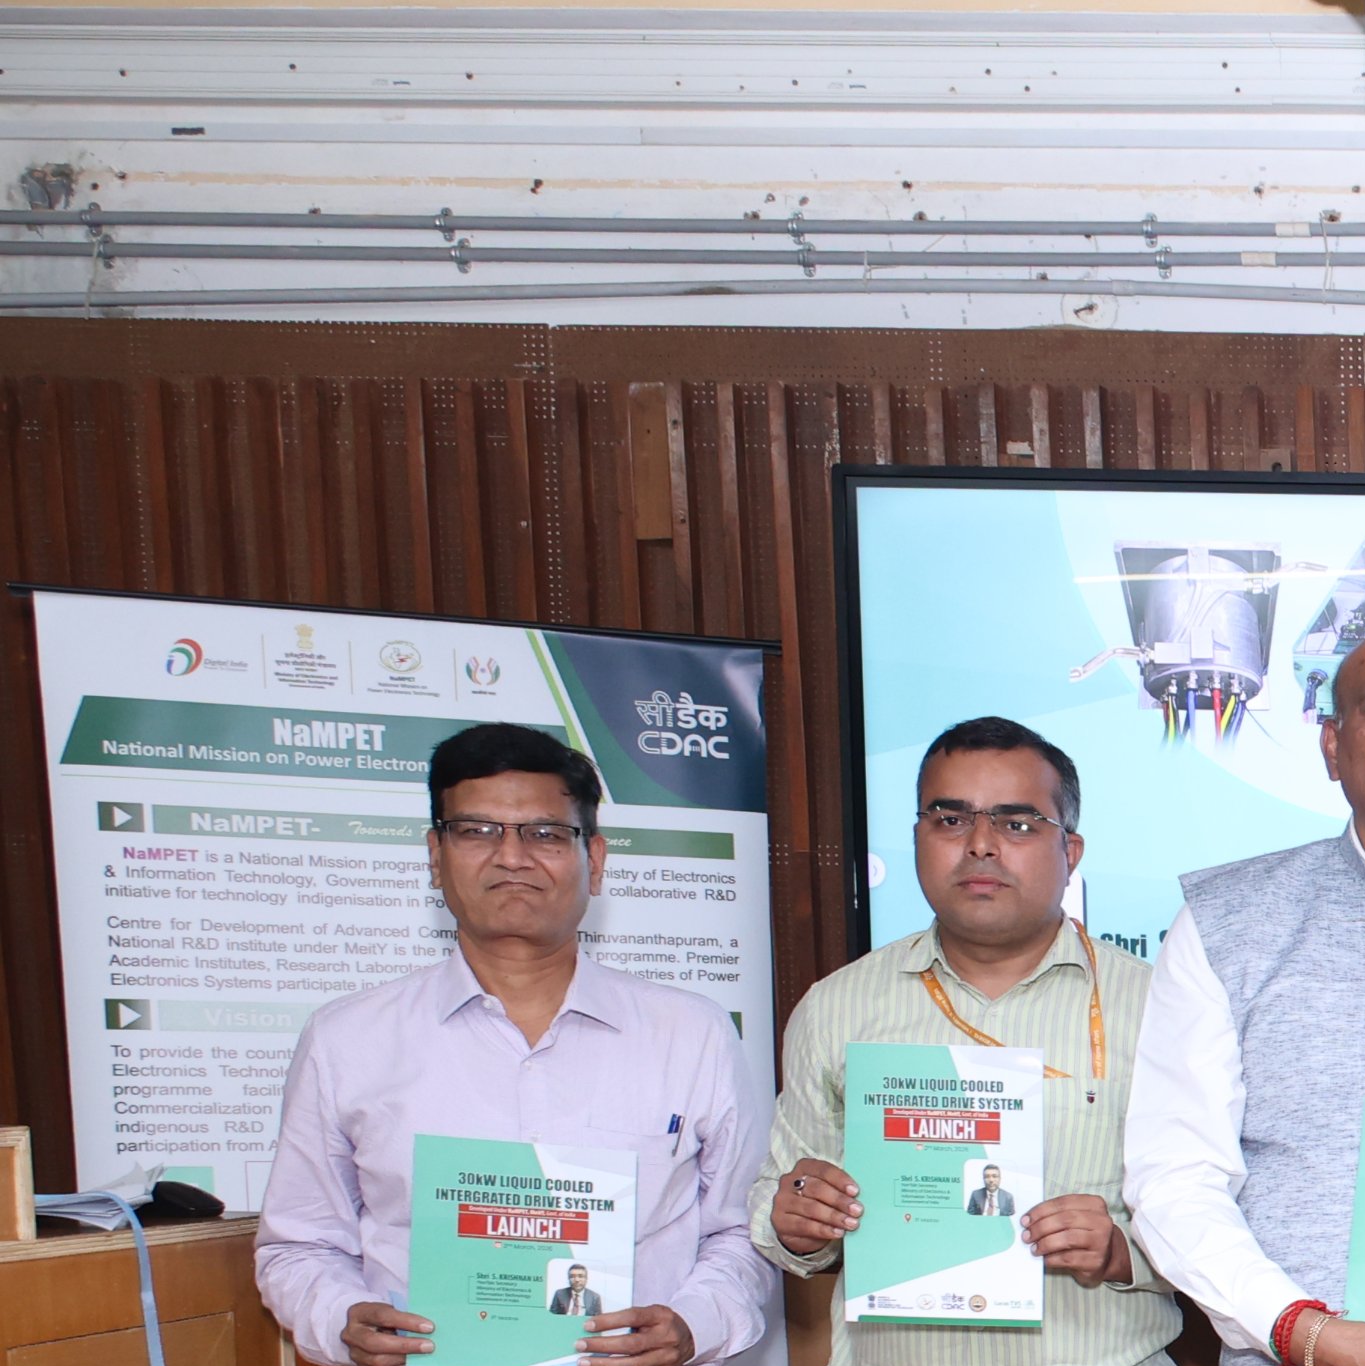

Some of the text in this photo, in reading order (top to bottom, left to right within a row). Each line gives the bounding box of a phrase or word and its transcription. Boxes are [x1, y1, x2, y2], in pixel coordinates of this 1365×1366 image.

[272, 717, 386, 751] NaMPET
[637, 731, 730, 759] CDAC
[102, 739, 429, 772] National Mission on Power Electron
[122, 846, 367, 869] NaMPET is a National Mission
[103, 864, 115, 877] &
[126, 865, 215, 881] Information
[325, 871, 418, 889] Government
[643, 868, 736, 884] of Electronics
[104, 884, 419, 907] initiative for technology indigenisation in
[608, 885, 736, 901] collaborative R&D
[106, 915, 409, 937] Centre for Development of Advanced
[108, 935, 435, 956] National R&D institute under MeitY is the
[729, 938, 738, 947] a
[108, 954, 188, 968] Academic
[275, 958, 350, 972] Research
[686, 951, 739, 964] Premier
[109, 973, 373, 993] Electronics Systems participate in
[679, 968, 740, 981] of Power
[204, 1008, 293, 1028] Vision
[110, 1044, 237, 1059] To provide the
[111, 1063, 207, 1077] Electronics
[113, 1085, 212, 1098] programme
[882, 1076, 1003, 1092] 30kW LIQUID COOLED
[113, 1101, 272, 1115] Commercialization
[864, 1093, 1023, 1110] INTERGRATED DRIVE SYSTEM
[115, 1120, 264, 1135] indigenous R&D
[909, 1118, 976, 1140] LAUNCH
[116, 1138, 264, 1154] participation from
[458, 1171, 593, 1193] 30kW LIQUID COOLED
[435, 1187, 614, 1211] INTERGRATED DRIVE SYSTEM
[487, 1215, 561, 1239] LAUNCH
